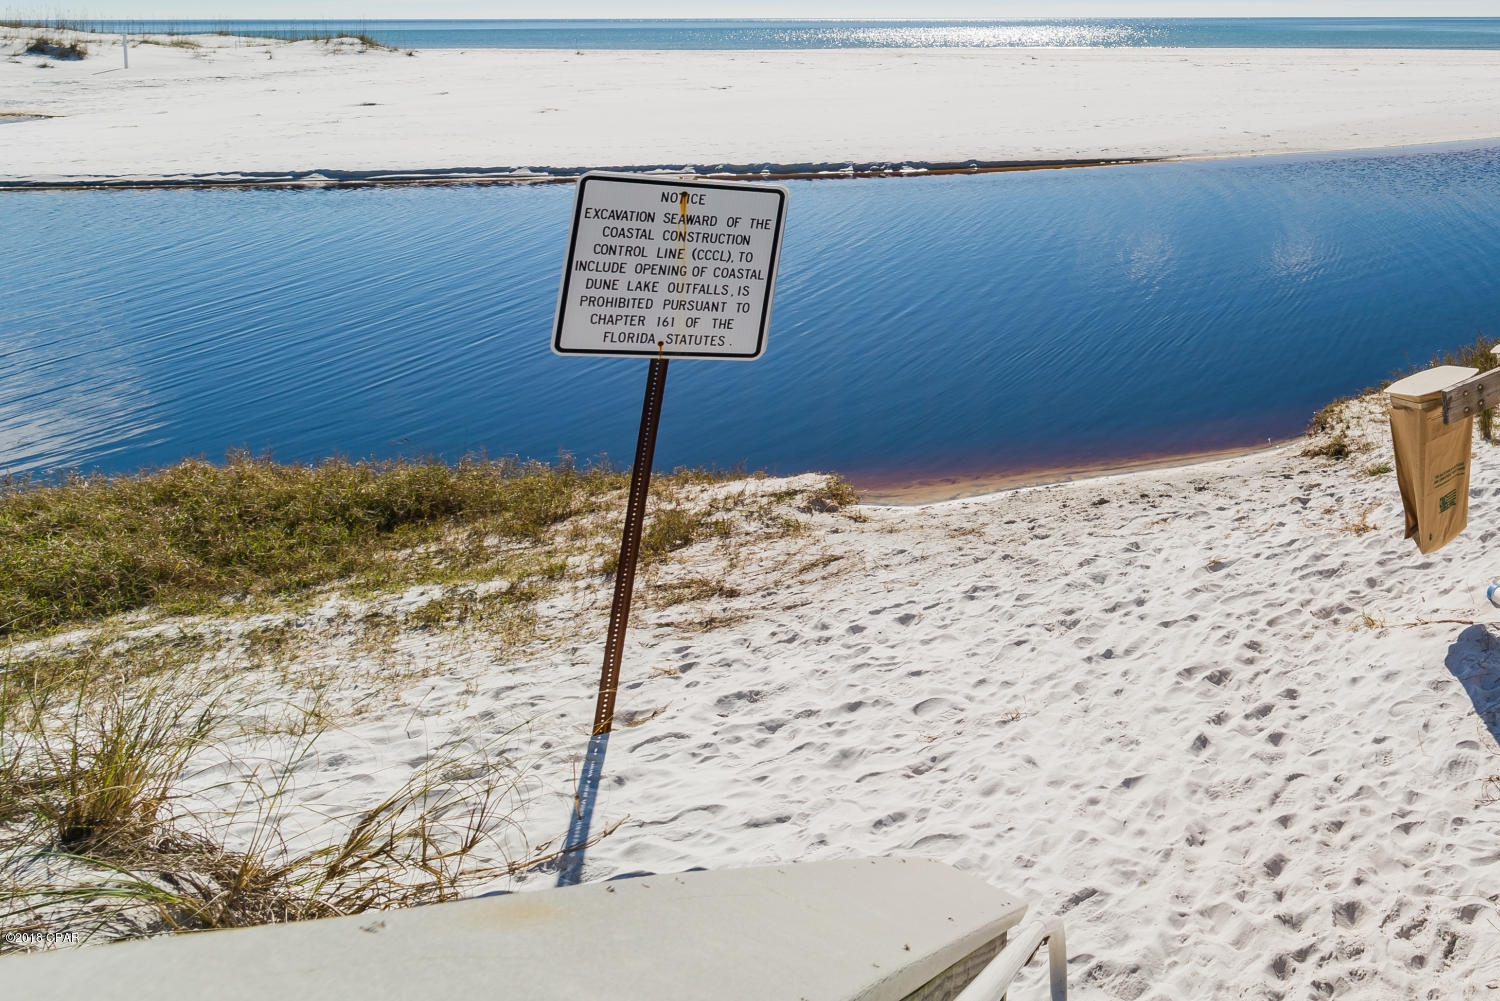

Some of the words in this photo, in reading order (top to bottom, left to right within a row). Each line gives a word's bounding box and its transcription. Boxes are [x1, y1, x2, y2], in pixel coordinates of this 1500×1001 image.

[660, 191, 707, 205] NOTICE
[584, 208, 656, 222] EXCAVATION
[663, 213, 718, 227] SEAWARD
[726, 217, 742, 228] OF
[750, 218, 772, 230] THE
[602, 226, 654, 240] COASTAL
[662, 230, 751, 245] CONSTRUCTION
[593, 244, 648, 258] CONTROL
[657, 248, 685, 260] LINE
[738, 252, 753, 263] TO
[575, 261, 627, 274] INCLUDE
[635, 263, 687, 277] OPENING
[692, 266, 708, 277] OF
[713, 268, 764, 281] COASTAL
[586, 278, 619, 291] DUNE
[627, 281, 659, 292] LAKE
[738, 285, 750, 296] IS
[580, 296, 653, 310] PROHIBITED
[663, 299, 727, 313] PURSUANT
[736, 302, 750, 313] TO
[590, 314, 645, 326] CHAPTER
[657, 317, 675, 328] 161
[686, 318, 700, 329] OF
[712, 319, 734, 329] THE
[603, 332, 655, 344] FLORIDA
